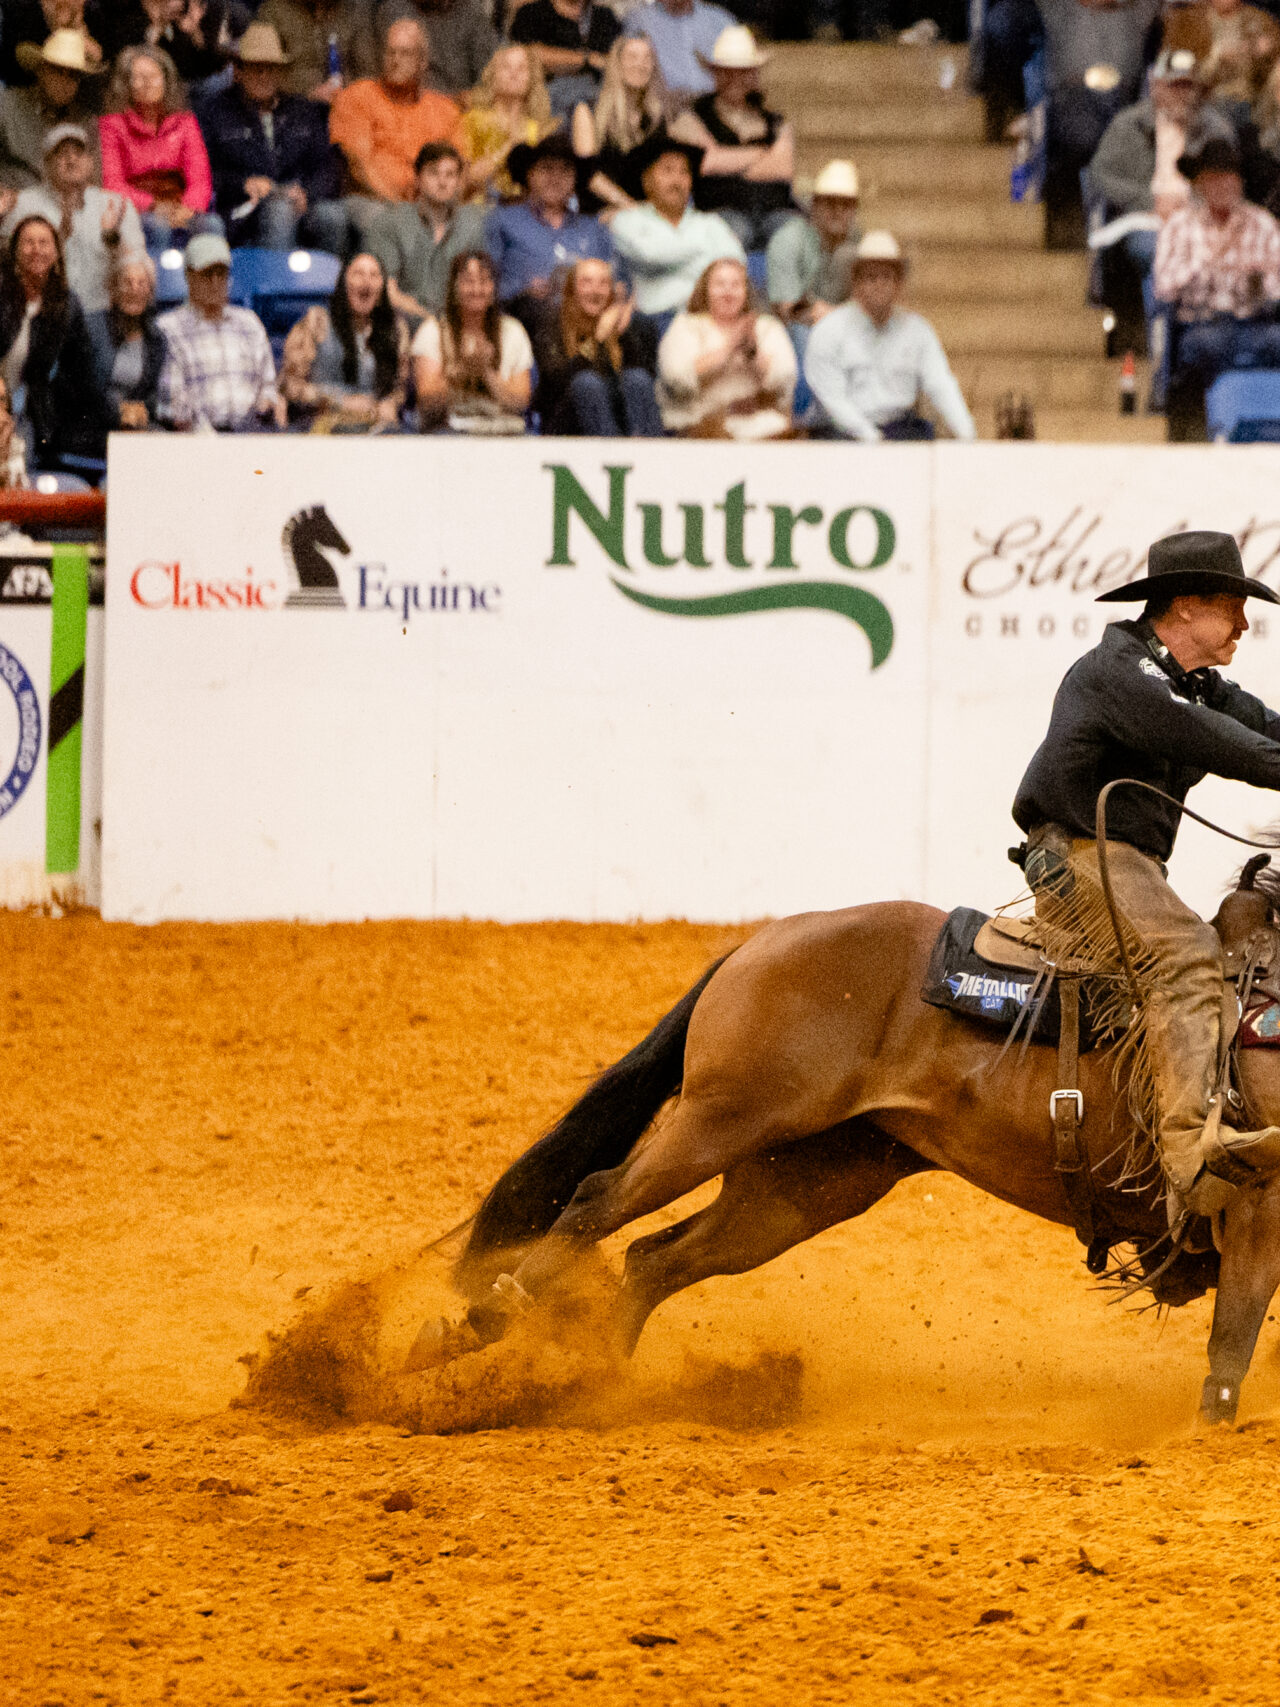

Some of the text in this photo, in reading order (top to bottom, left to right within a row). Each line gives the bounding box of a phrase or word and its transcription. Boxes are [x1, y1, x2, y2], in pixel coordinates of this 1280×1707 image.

[541, 463, 897, 571] Nutro
[129, 562, 502, 622] Classic Equine
